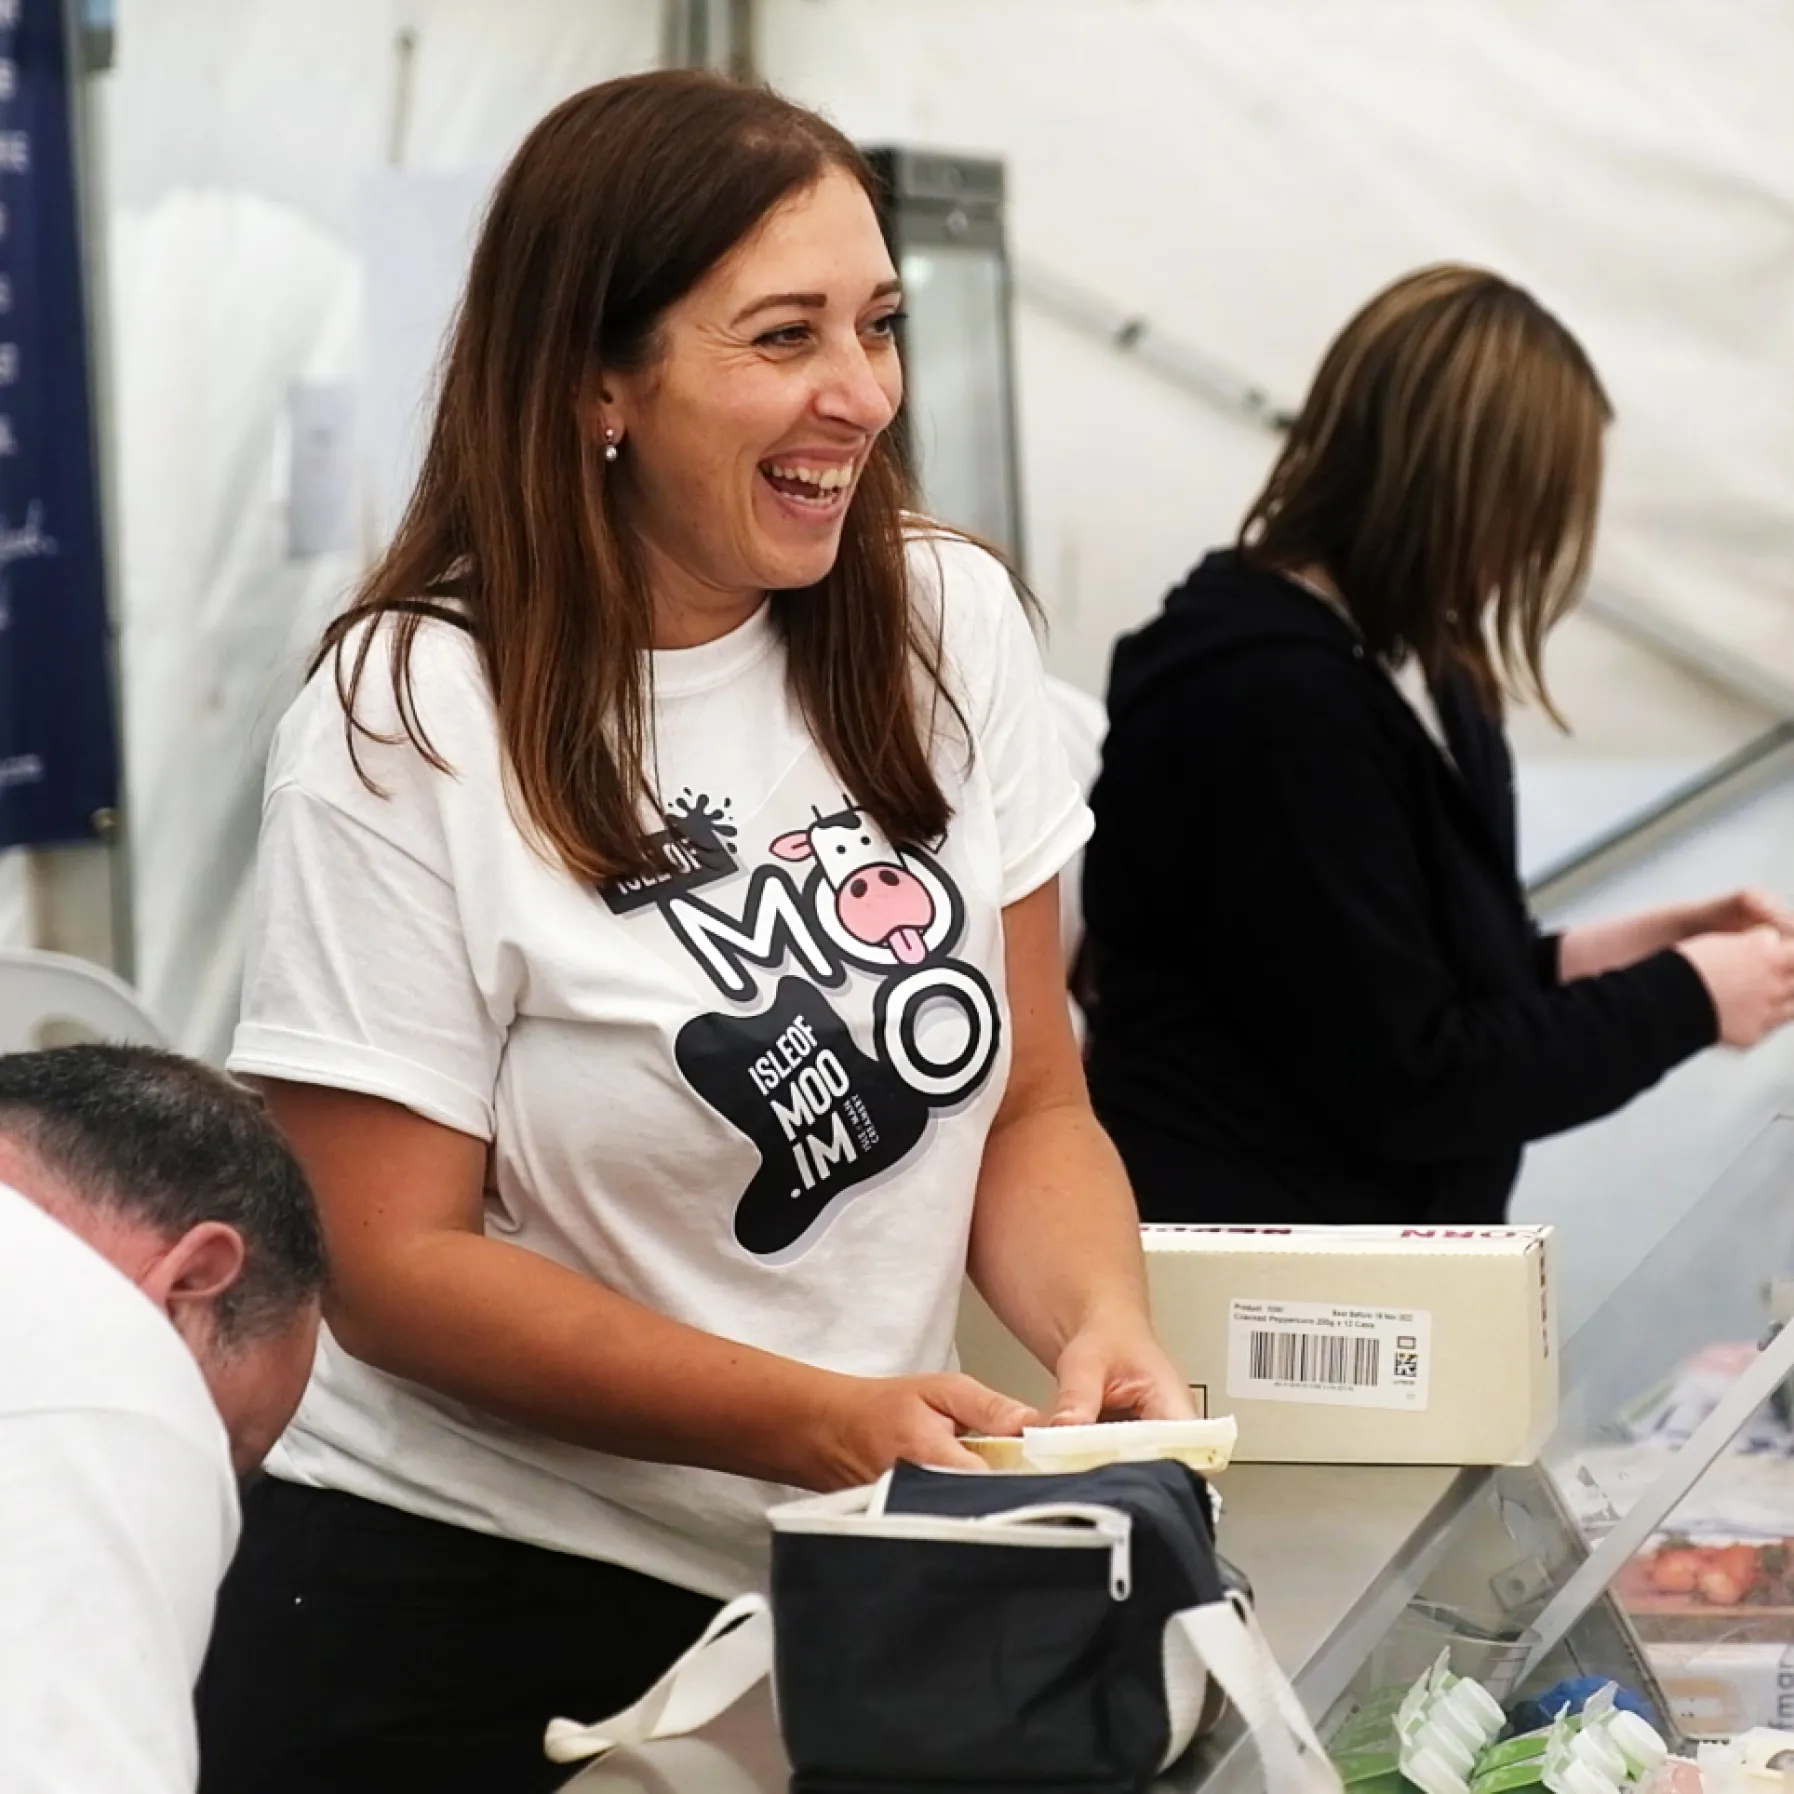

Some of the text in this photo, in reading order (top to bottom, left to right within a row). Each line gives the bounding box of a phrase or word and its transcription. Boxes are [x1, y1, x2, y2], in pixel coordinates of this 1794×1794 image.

[748, 1014, 818, 1096] ISLEOF
[769, 1049, 849, 1142] MOO
[790, 1111, 858, 1199] .IM
